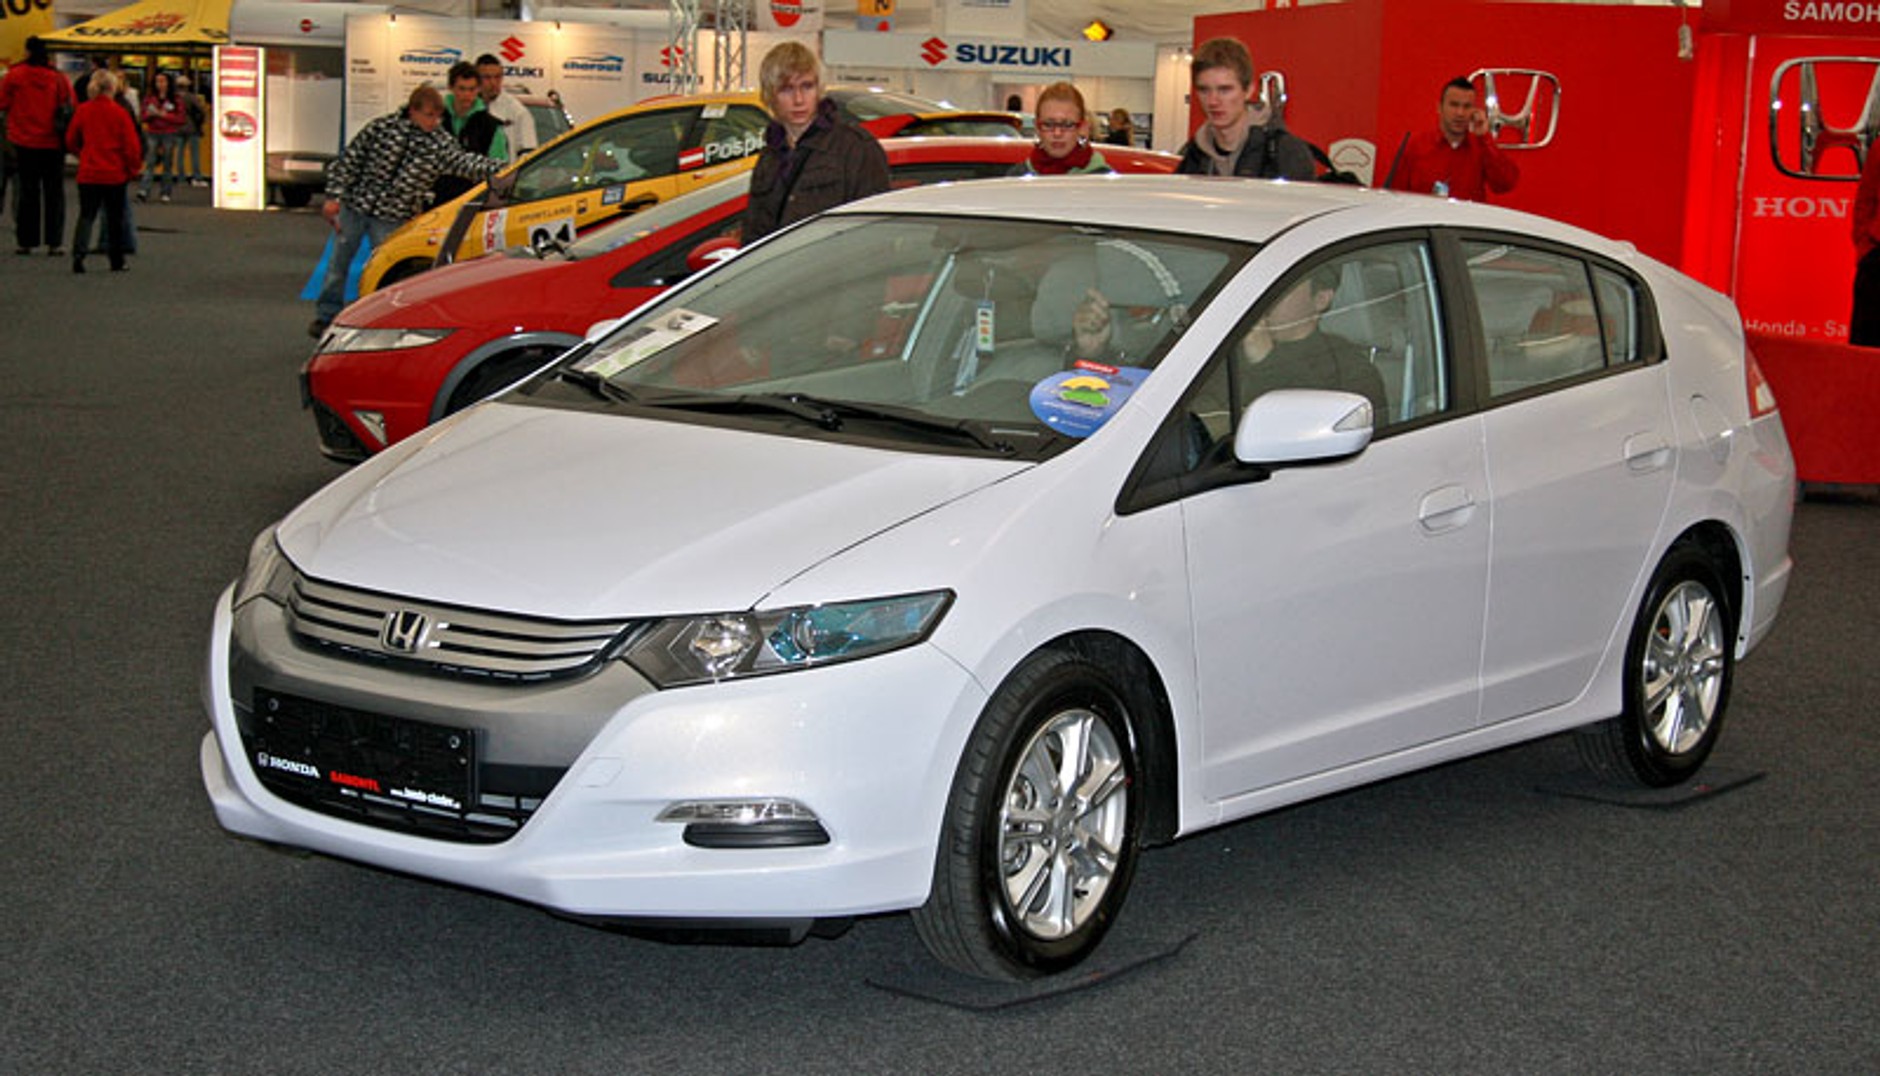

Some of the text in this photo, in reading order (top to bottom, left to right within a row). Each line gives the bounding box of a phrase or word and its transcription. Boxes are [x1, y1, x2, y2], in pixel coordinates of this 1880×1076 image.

[956, 43, 1071, 66] SUZUKI
[503, 66, 544, 78] ZUKI
[1753, 197, 1850, 218] HON
[1824, 320, 1849, 337] Sa
[270, 756, 321, 779] HONDA
